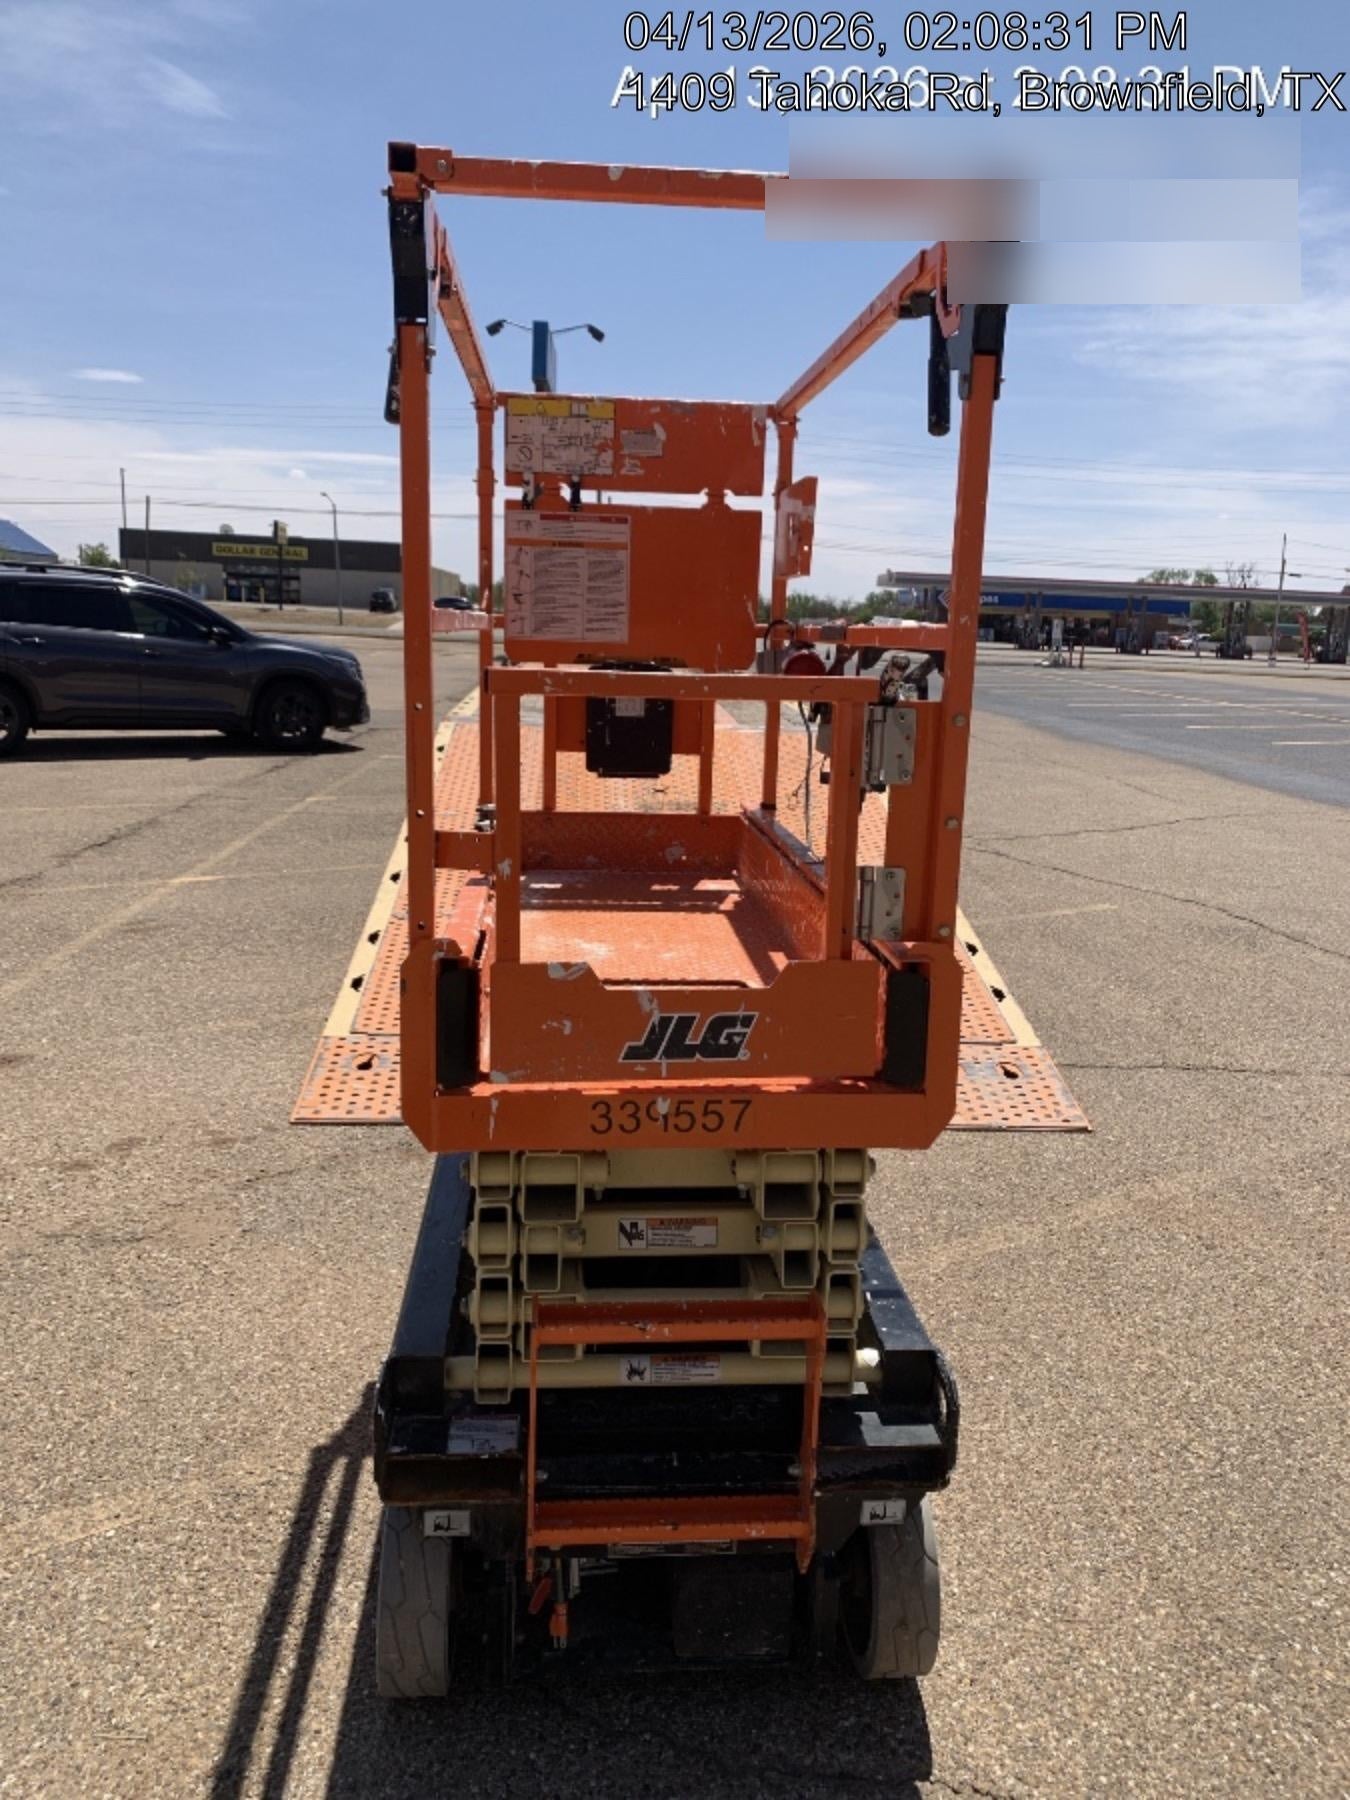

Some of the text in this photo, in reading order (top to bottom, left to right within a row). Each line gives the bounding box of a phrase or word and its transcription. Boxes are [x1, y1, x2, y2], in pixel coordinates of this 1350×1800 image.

[215, 545, 304, 558] DOLLAR GENRAL
[618, 1012, 759, 1063] JLG
[590, 1099, 752, 1134] 339557
